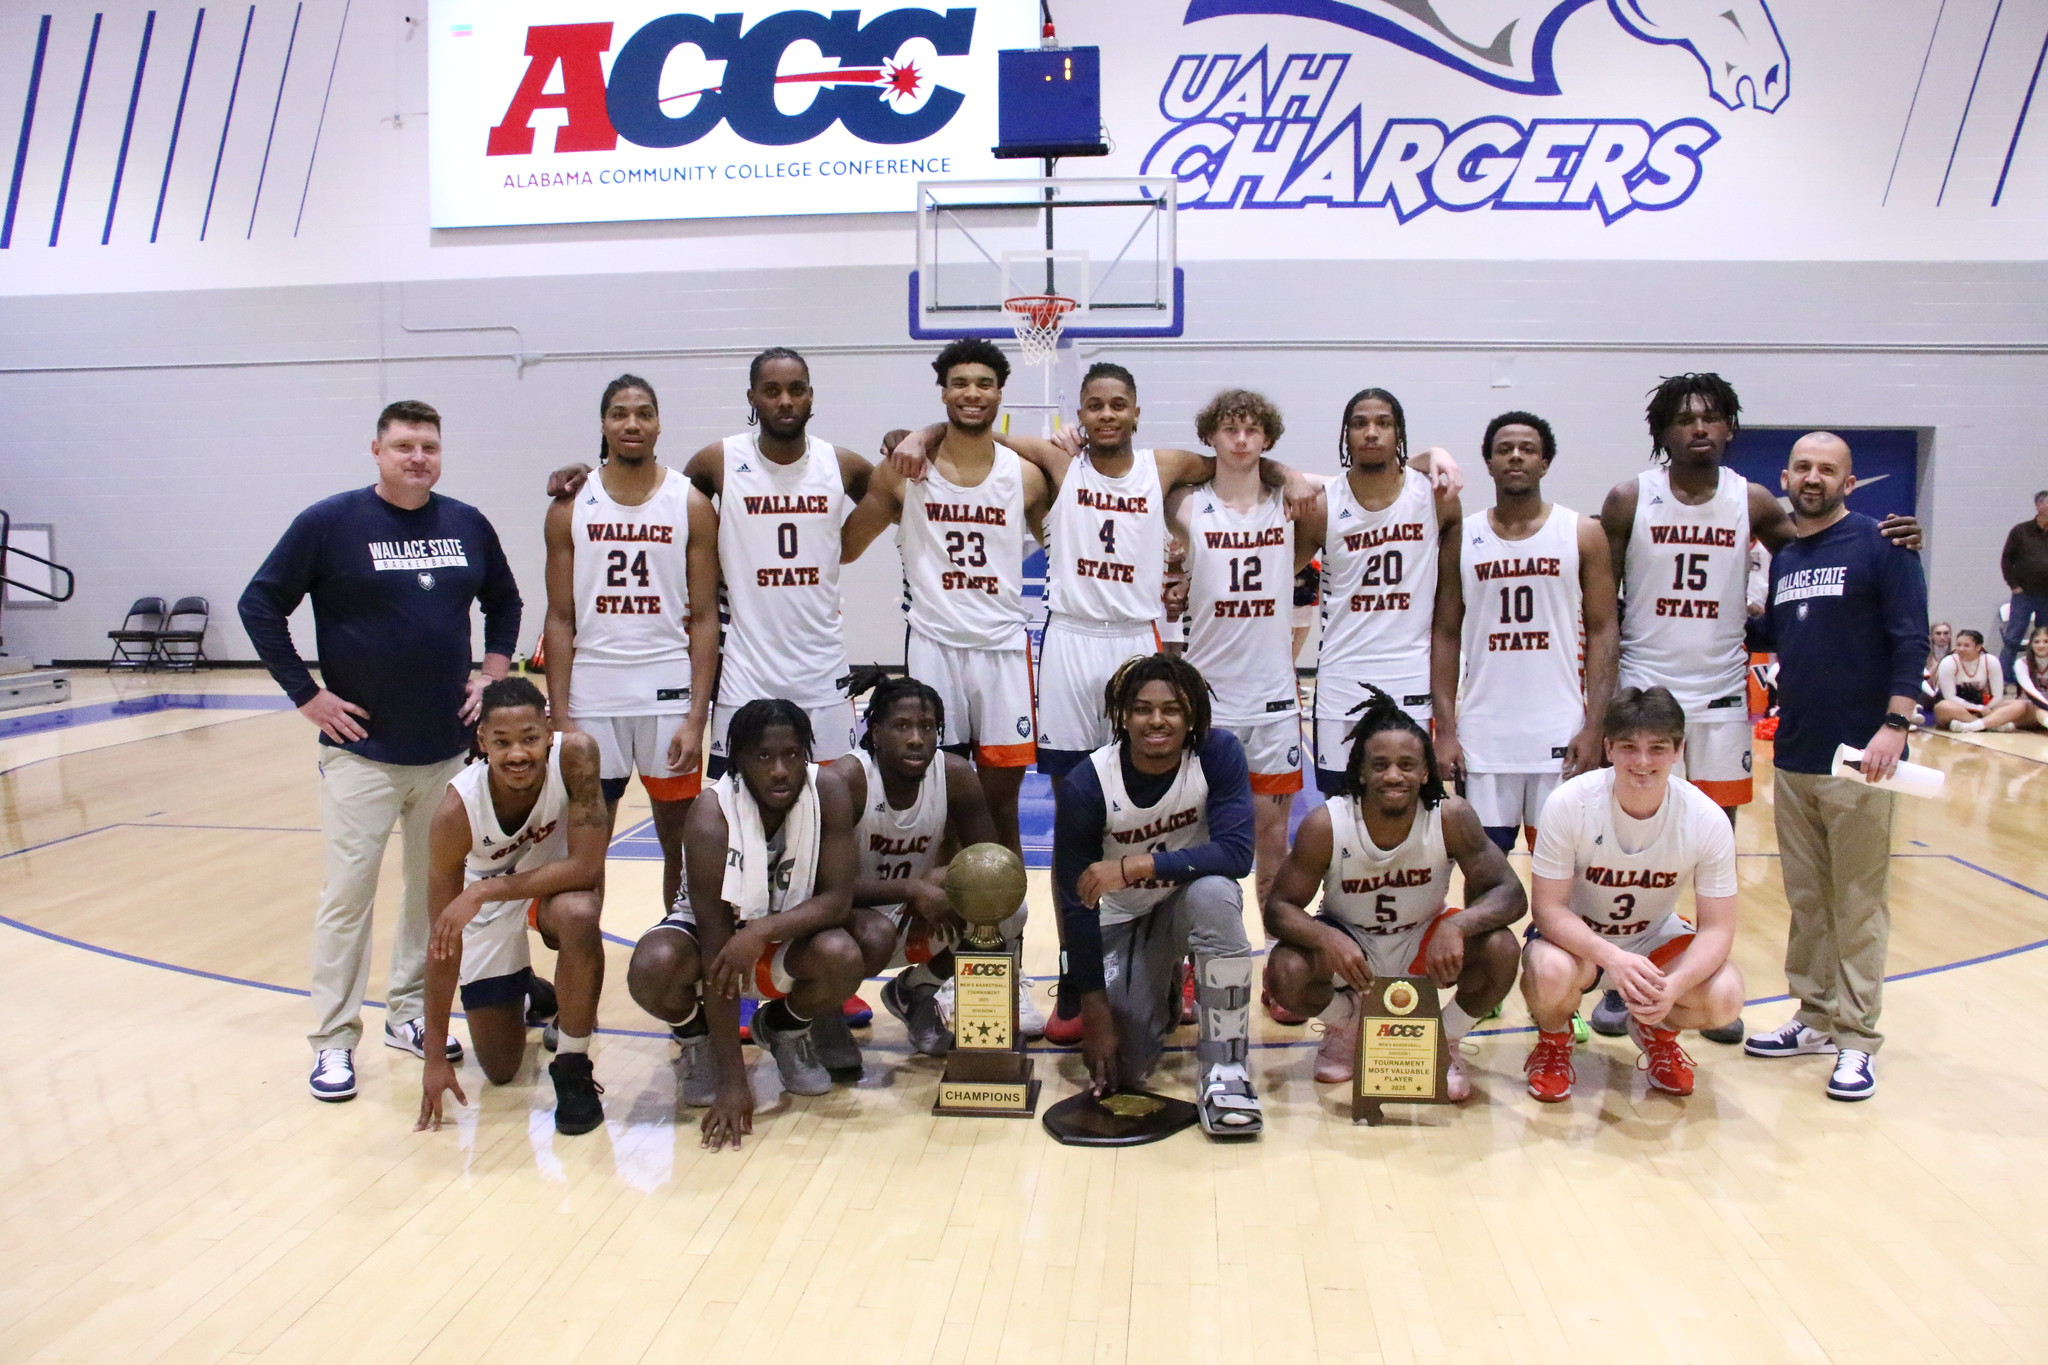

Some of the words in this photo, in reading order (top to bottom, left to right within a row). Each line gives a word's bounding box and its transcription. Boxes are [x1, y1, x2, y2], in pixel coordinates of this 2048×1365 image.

[486, 8, 977, 156] ACCC
[1159, 43, 1352, 122] UAH
[503, 171, 593, 188] ALABAMA
[600, 165, 718, 184] COMMUNITY
[724, 162, 812, 180] COLLEGE
[819, 158, 951, 176] CONFERENCE
[1140, 103, 1722, 226] CHARGERS
[743, 495, 828, 514] WALLACE
[1077, 488, 1148, 514] WALLACE
[924, 503, 1006, 526] WALLACE
[587, 523, 673, 544] WALLACE
[777, 522, 798, 559] 0
[1098, 519, 1116, 554] 4
[1204, 527, 1285, 549] WALLACE
[1343, 523, 1424, 552] WALLACE
[1650, 525, 1736, 548] WALLACE
[368, 540, 428, 559] WALLACE
[429, 539, 465, 556] STATE
[945, 531, 987, 567] 23
[383, 557, 460, 569] BASKETBALL
[606, 550, 650, 587] 24
[1077, 558, 1135, 583] STATE
[1229, 555, 1262, 592] 12
[1361, 550, 1402, 587] 20
[1474, 557, 1560, 582] WALLACE
[1672, 553, 1710, 591] 15
[756, 567, 819, 586] STATE
[1812, 566, 1847, 585] STATE
[595, 595, 661, 614] STATE
[1214, 598, 1276, 618] STATE
[1350, 592, 1411, 612] STATE
[1499, 585, 1534, 624] 10
[1655, 597, 1719, 619] STATE
[1488, 631, 1549, 651] STATE
[1341, 867, 1432, 894] WALLACE
[1585, 866, 1678, 889] WALLACE
[1375, 894, 1397, 922] 5
[1609, 893, 1636, 920] 3
[960, 963, 1007, 976] ACCC
[1376, 1024, 1425, 1038] ACCC
[1374, 1059, 1425, 1067] TOURNAMENT
[945, 1090, 1021, 1103] CHAMPIONS
